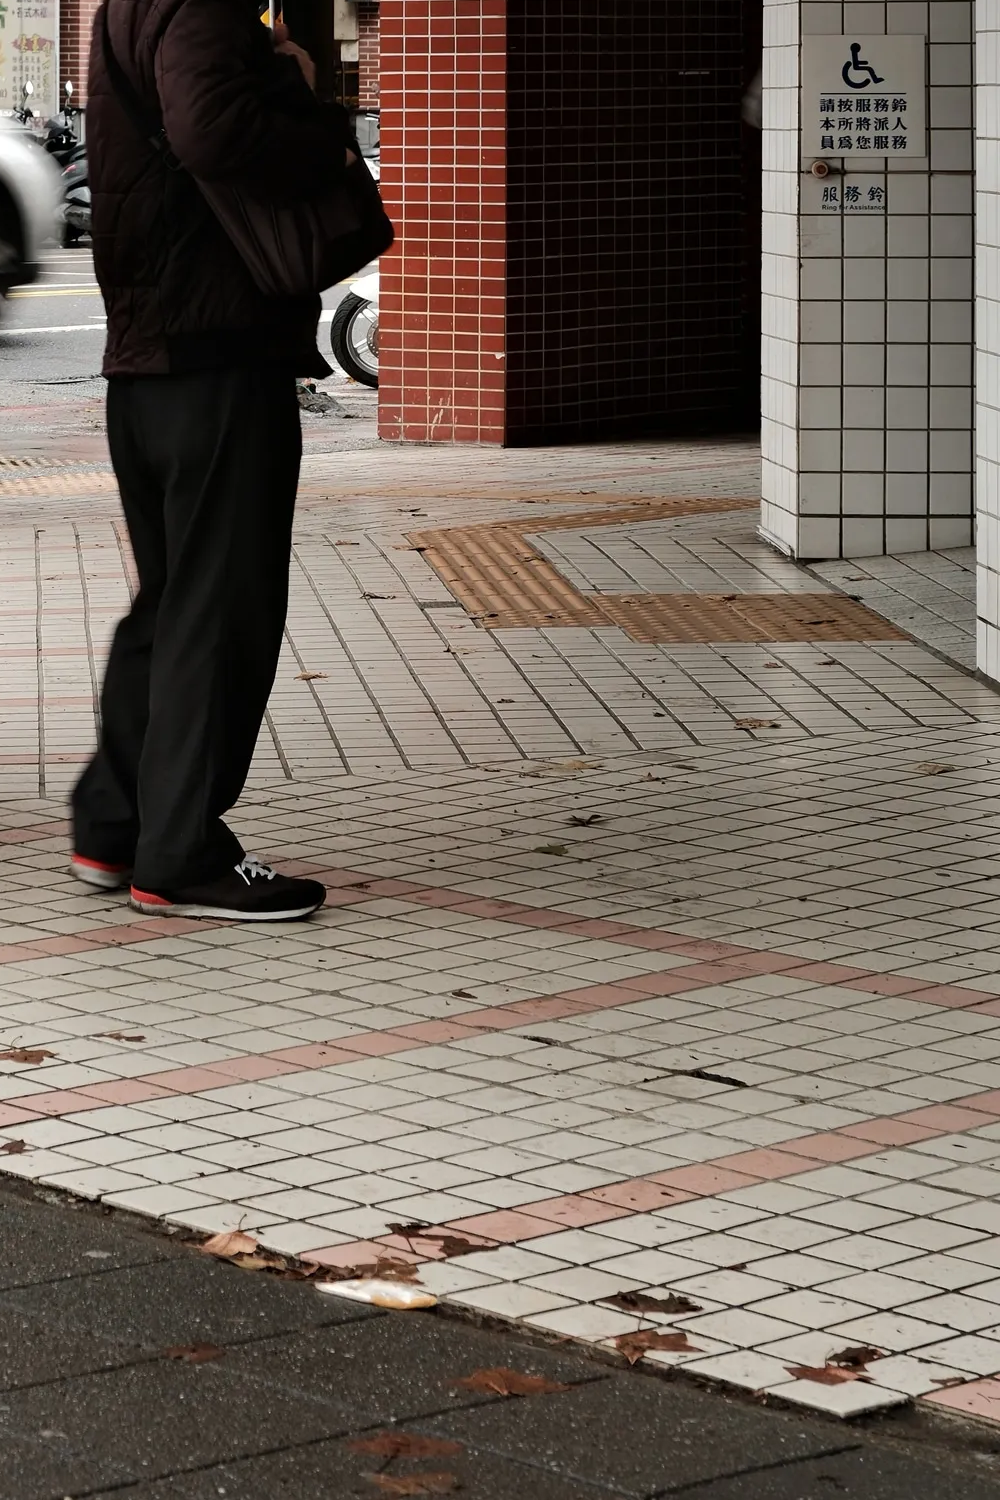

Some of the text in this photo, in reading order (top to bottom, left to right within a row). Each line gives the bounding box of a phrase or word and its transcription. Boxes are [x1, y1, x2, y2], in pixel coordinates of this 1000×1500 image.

[819, 98, 908, 113] 請按服務鈴
[819, 116, 908, 131] 本所將派人
[821, 185, 886, 203] 服務鈴
